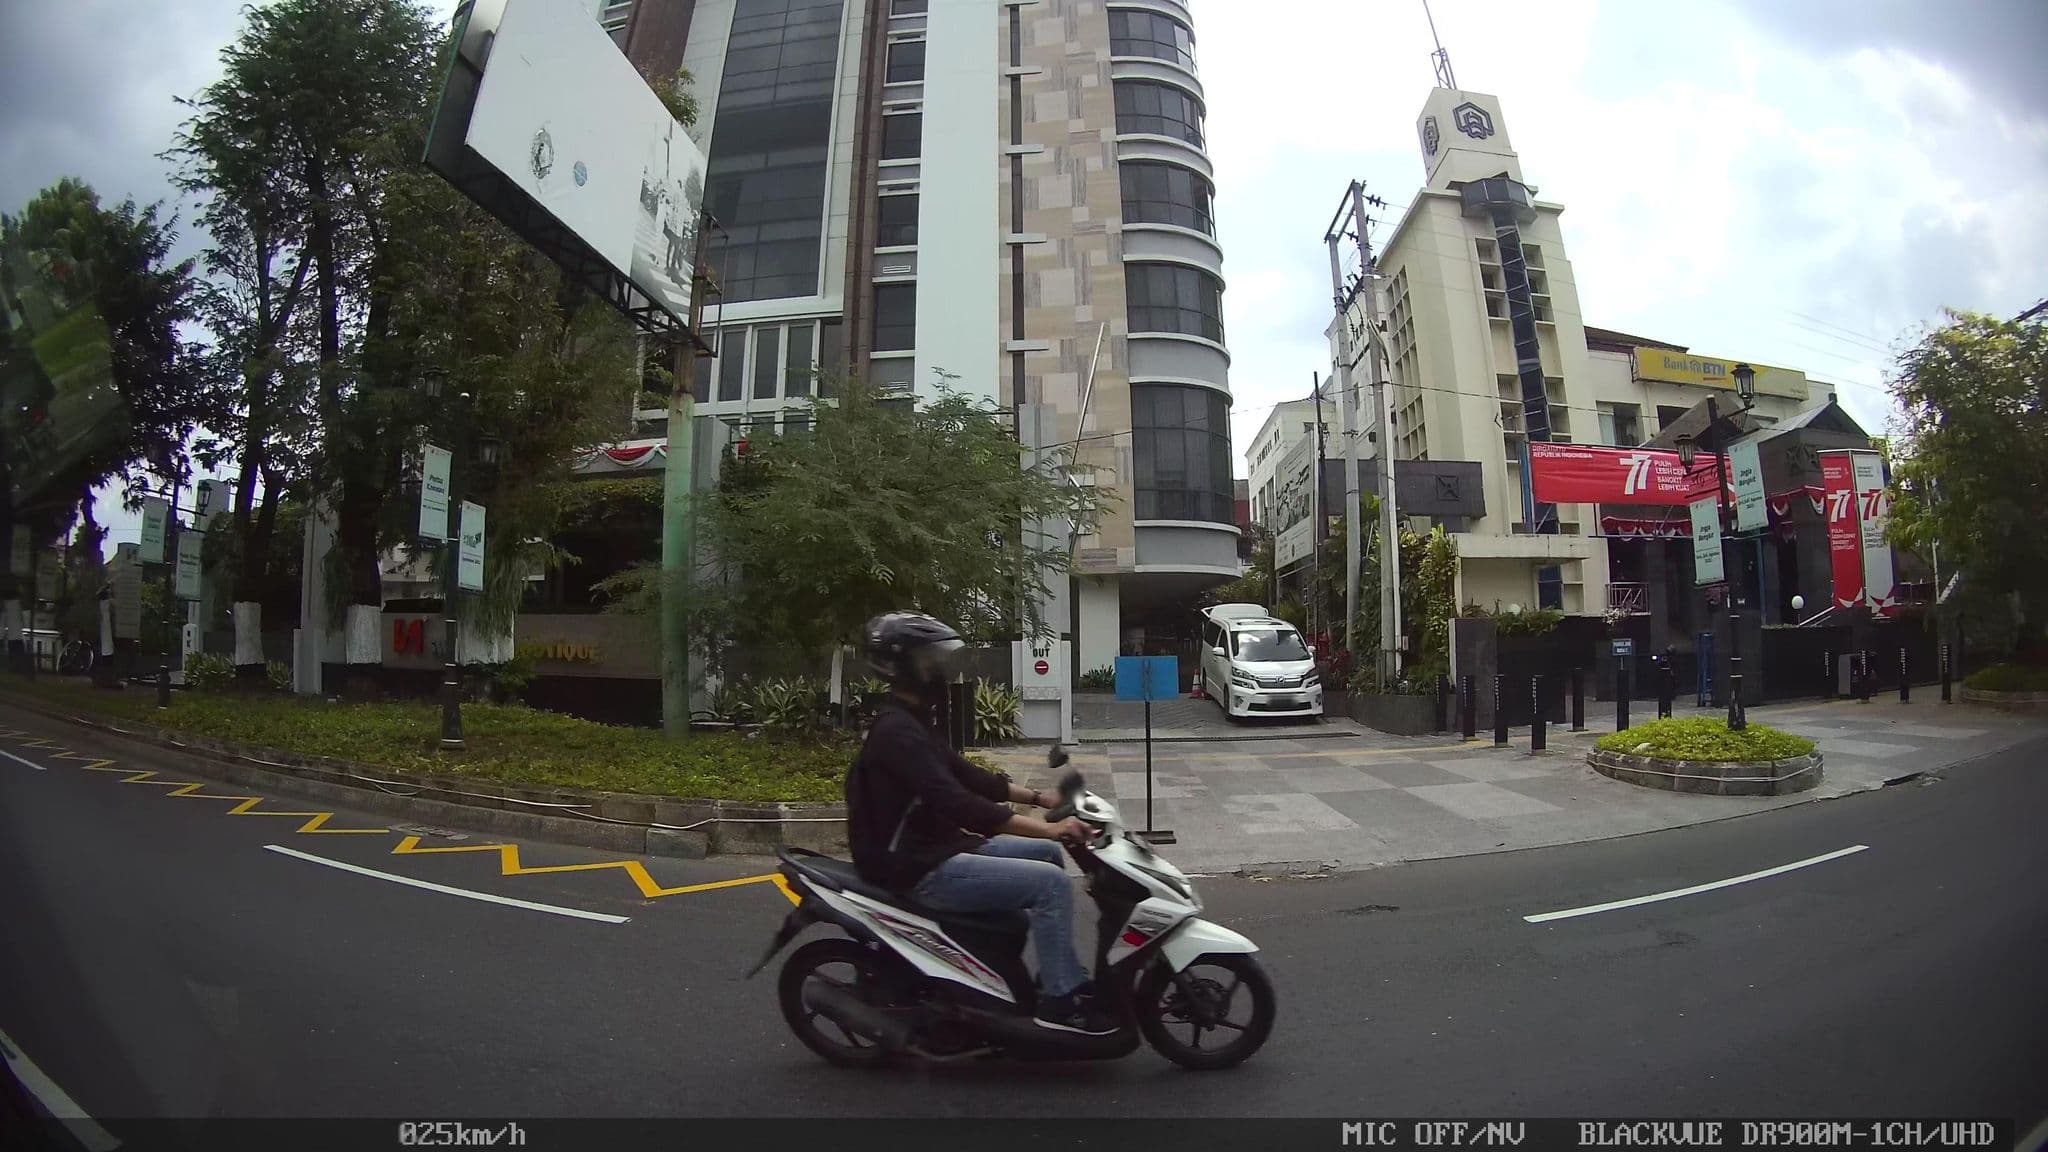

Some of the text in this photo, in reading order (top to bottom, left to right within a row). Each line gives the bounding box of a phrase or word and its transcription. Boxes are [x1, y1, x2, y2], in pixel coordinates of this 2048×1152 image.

[1663, 355, 1726, 377] Bank BTN
[1561, 451, 1593, 459] INDONESIA
[1619, 453, 1652, 495] 77
[1827, 489, 1851, 522] 77
[1860, 488, 1882, 520] 77
[1032, 648, 1050, 658] OUT
